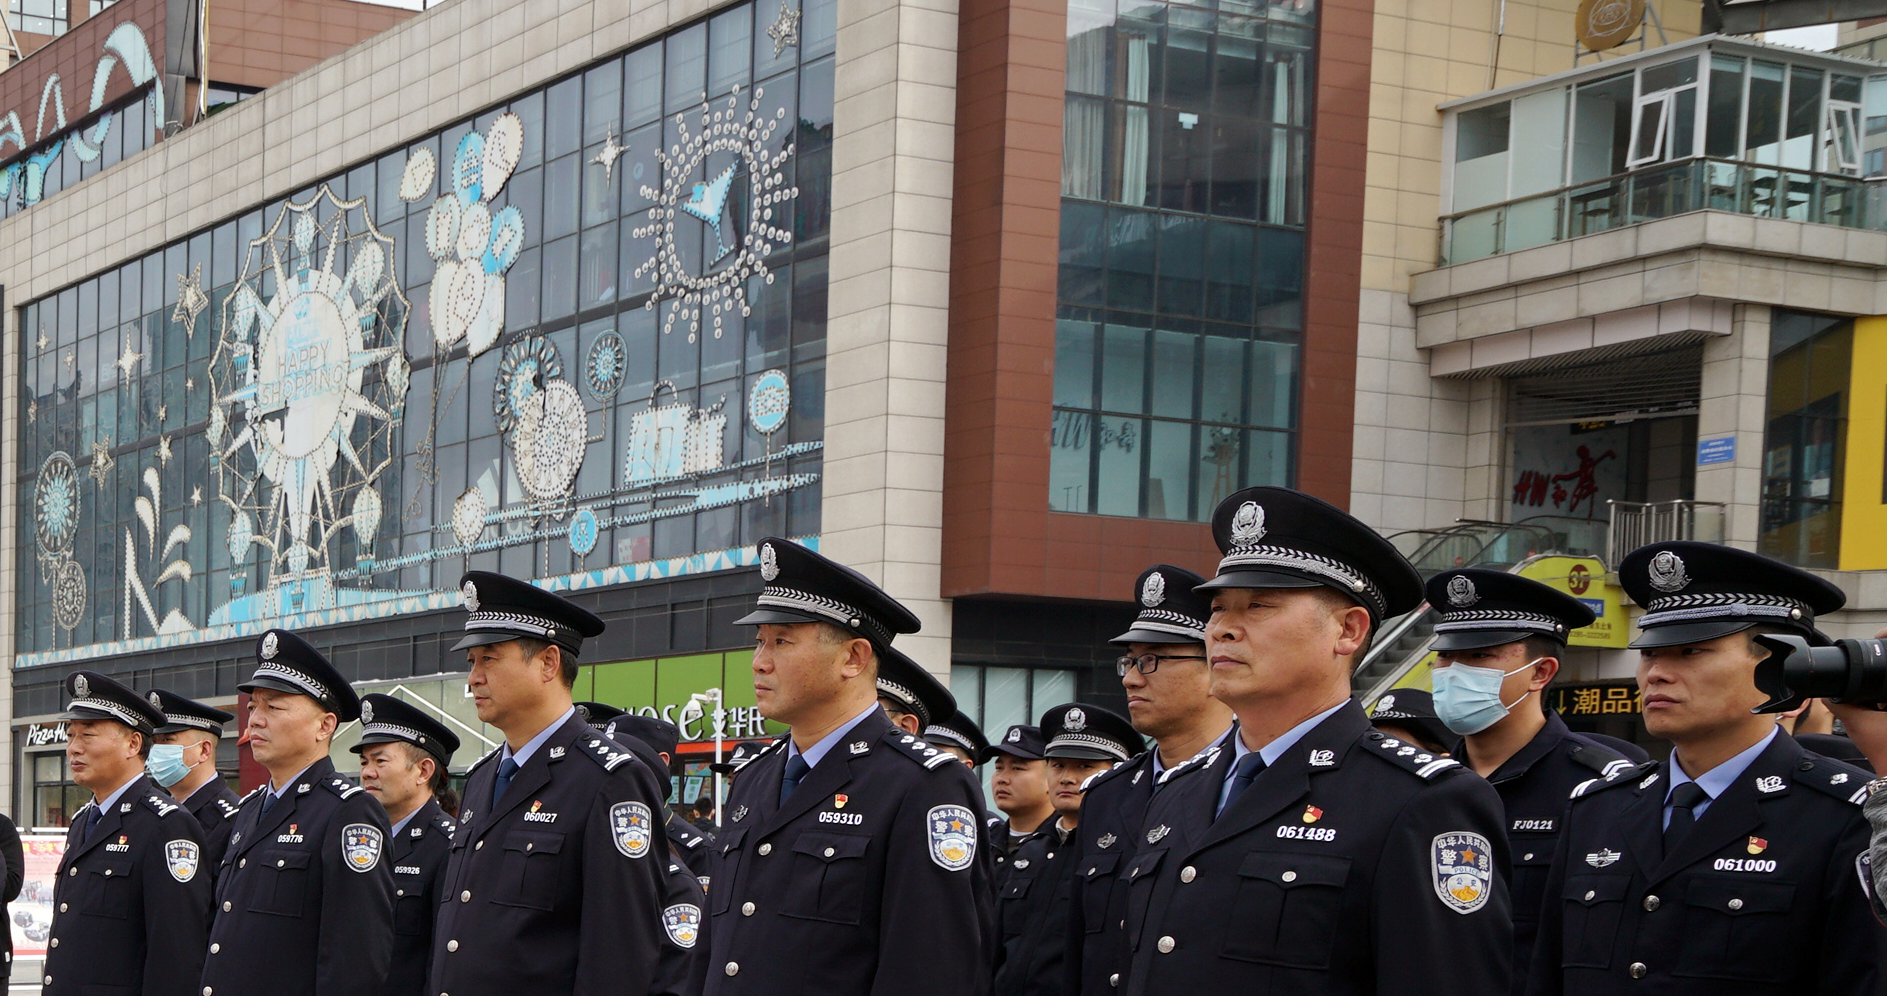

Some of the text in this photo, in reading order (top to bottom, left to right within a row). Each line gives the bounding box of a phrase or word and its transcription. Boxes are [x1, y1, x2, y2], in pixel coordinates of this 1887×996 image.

[278, 340, 331, 376] HAPPY
[261, 364, 345, 407] SHOPPING
[26, 723, 54, 747] Pizza
[523, 811, 558, 823] 060027
[818, 811, 863, 826] 059310
[1513, 820, 1553, 830] FJ0121
[277, 834, 304, 844] 059776
[1276, 825, 1336, 842] 061488
[105, 843, 130, 853] 059777
[1440, 848, 1488, 871] 警察
[1714, 858, 1777, 873] 061000
